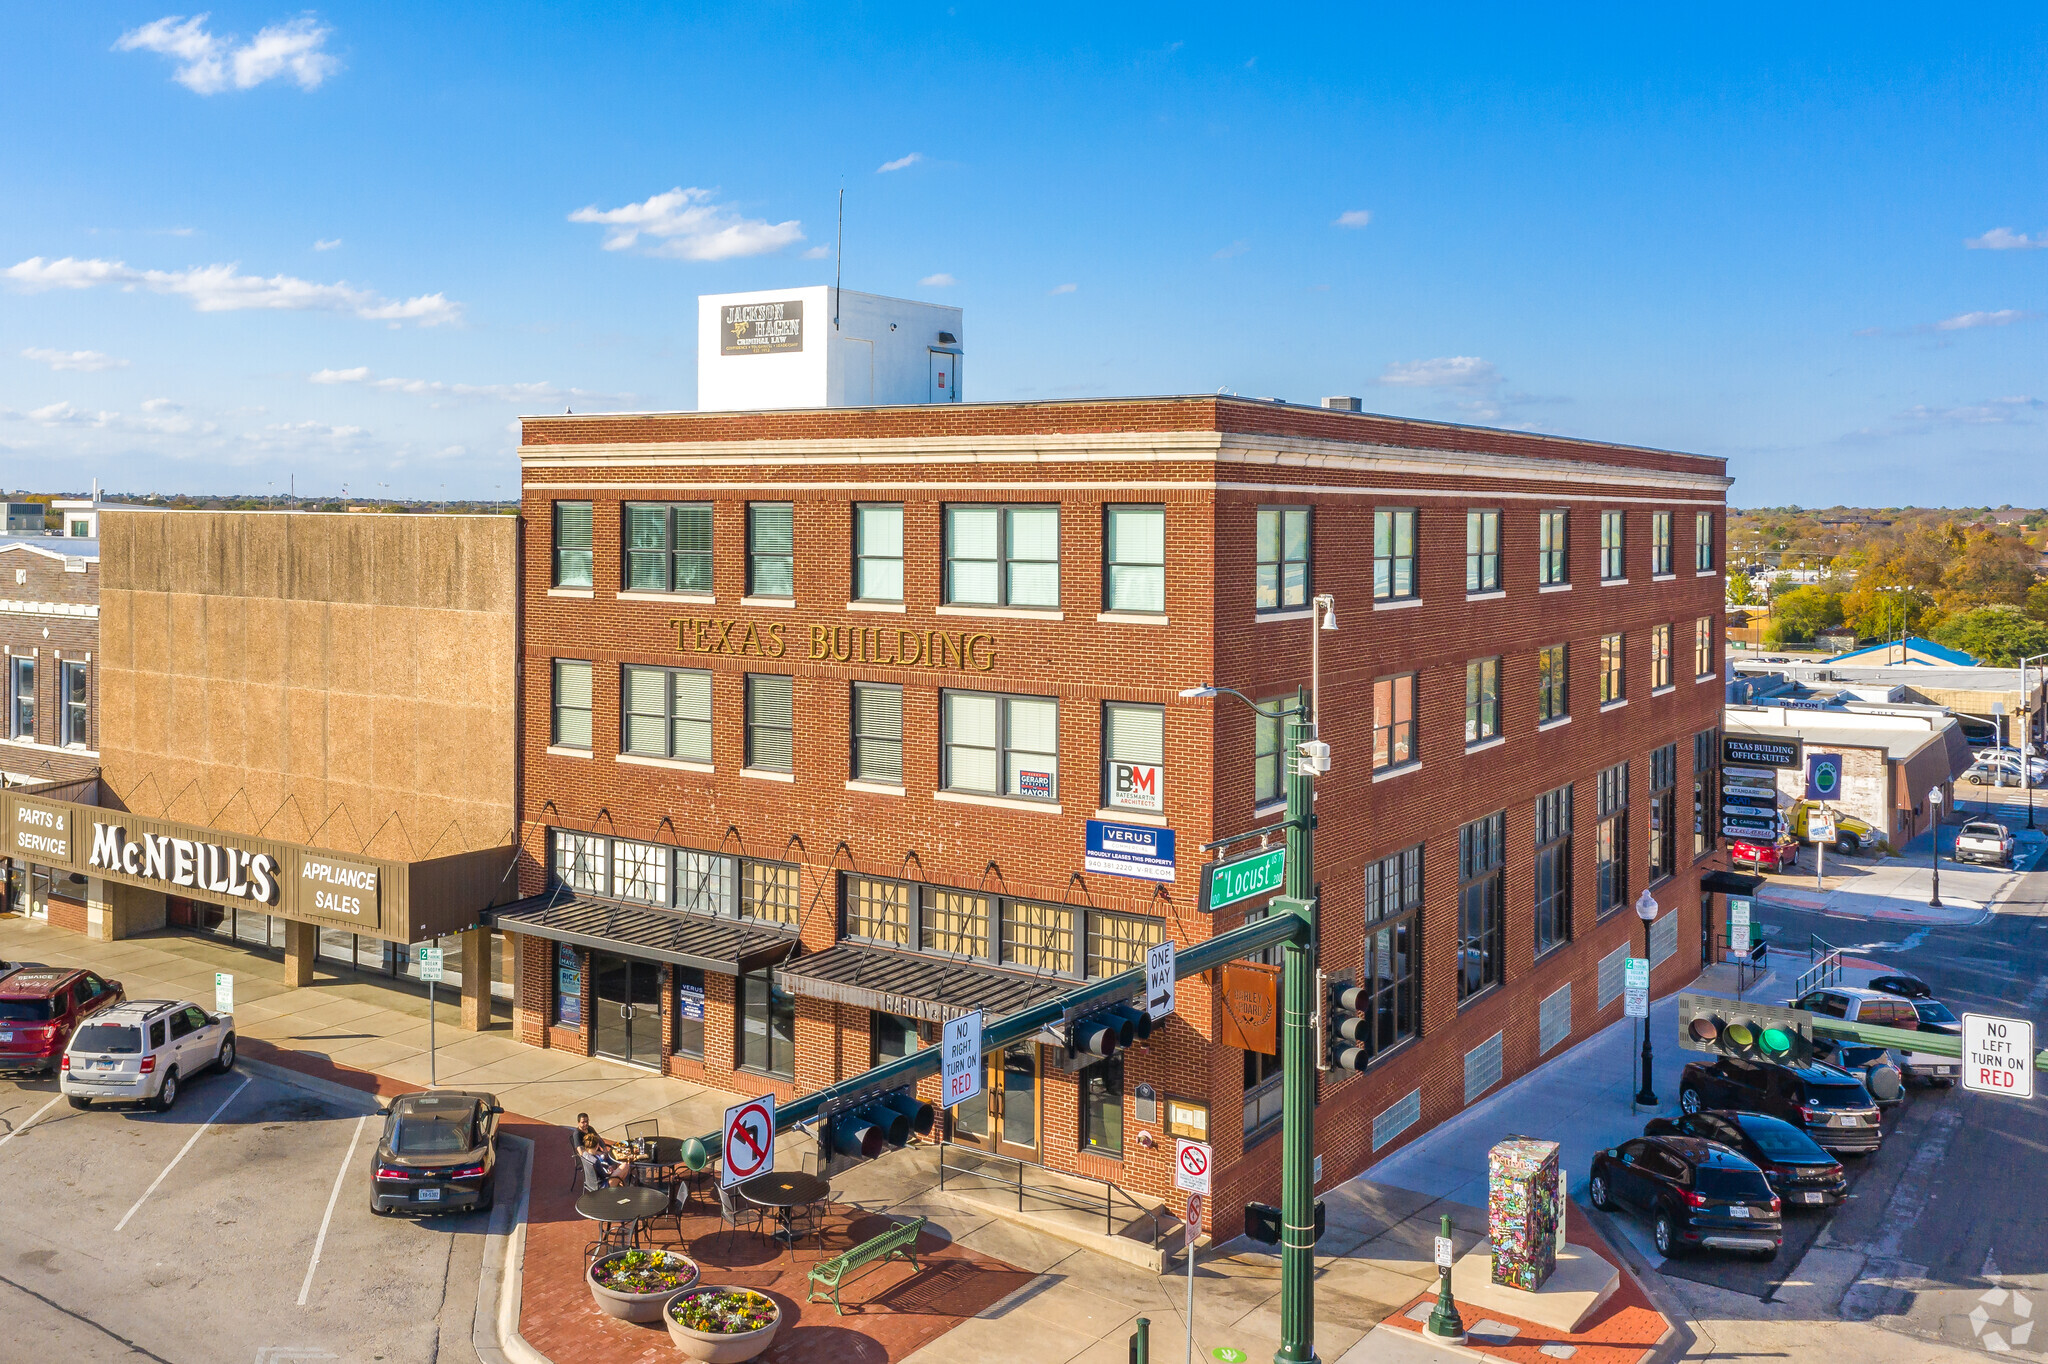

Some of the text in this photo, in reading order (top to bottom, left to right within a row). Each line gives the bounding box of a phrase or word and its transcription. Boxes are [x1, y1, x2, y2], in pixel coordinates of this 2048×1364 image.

[727, 303, 784, 324] JACKSON
[755, 319, 800, 337] HAGEN
[737, 338, 769, 346] CRIMINAL
[669, 618, 997, 671] TEXAS BUILDING
[1780, 701, 1818, 709] DENTON
[1728, 741, 1794, 754] TEXAS BUILDING
[1732, 751, 1789, 763] OFFICE SUITES
[1021, 775, 1048, 784] GERARD
[1021, 788, 1048, 797] MAYOR
[1116, 792, 1155, 801] BATESMARTIN
[1121, 798, 1155, 807] ARCHITECTS
[18, 807, 64, 831] PARTS &
[18, 832, 66, 856] SERVICE
[1107, 830, 1152, 844] VERUS
[1087, 850, 1111, 858] PROUDLY
[1112, 852, 1131, 861] LEASES
[1145, 857, 1172, 866] PROPERTY
[302, 862, 376, 891] APPLIANCE
[1227, 859, 1270, 898] Locust
[315, 890, 360, 915] SALES
[421, 949, 427, 959] 2
[1151, 948, 1170, 970] ONE
[1627, 959, 1633, 968] 2
[1151, 966, 1170, 989] WAY
[682, 984, 703, 993] VERUS
[885, 994, 930, 1018] BARLEY
[931, 1010, 938, 1019] &
[957, 1022, 968, 1040] NO
[1987, 1022, 2007, 1038] NO
[951, 1039, 972, 1058] RIGHT
[1982, 1039, 2012, 1053] LEFT
[947, 1052, 977, 1077] TURN ON
[1971, 1052, 2024, 1070] TURN ON
[951, 1072, 971, 1097] RED
[1980, 1068, 2014, 1087] RED
